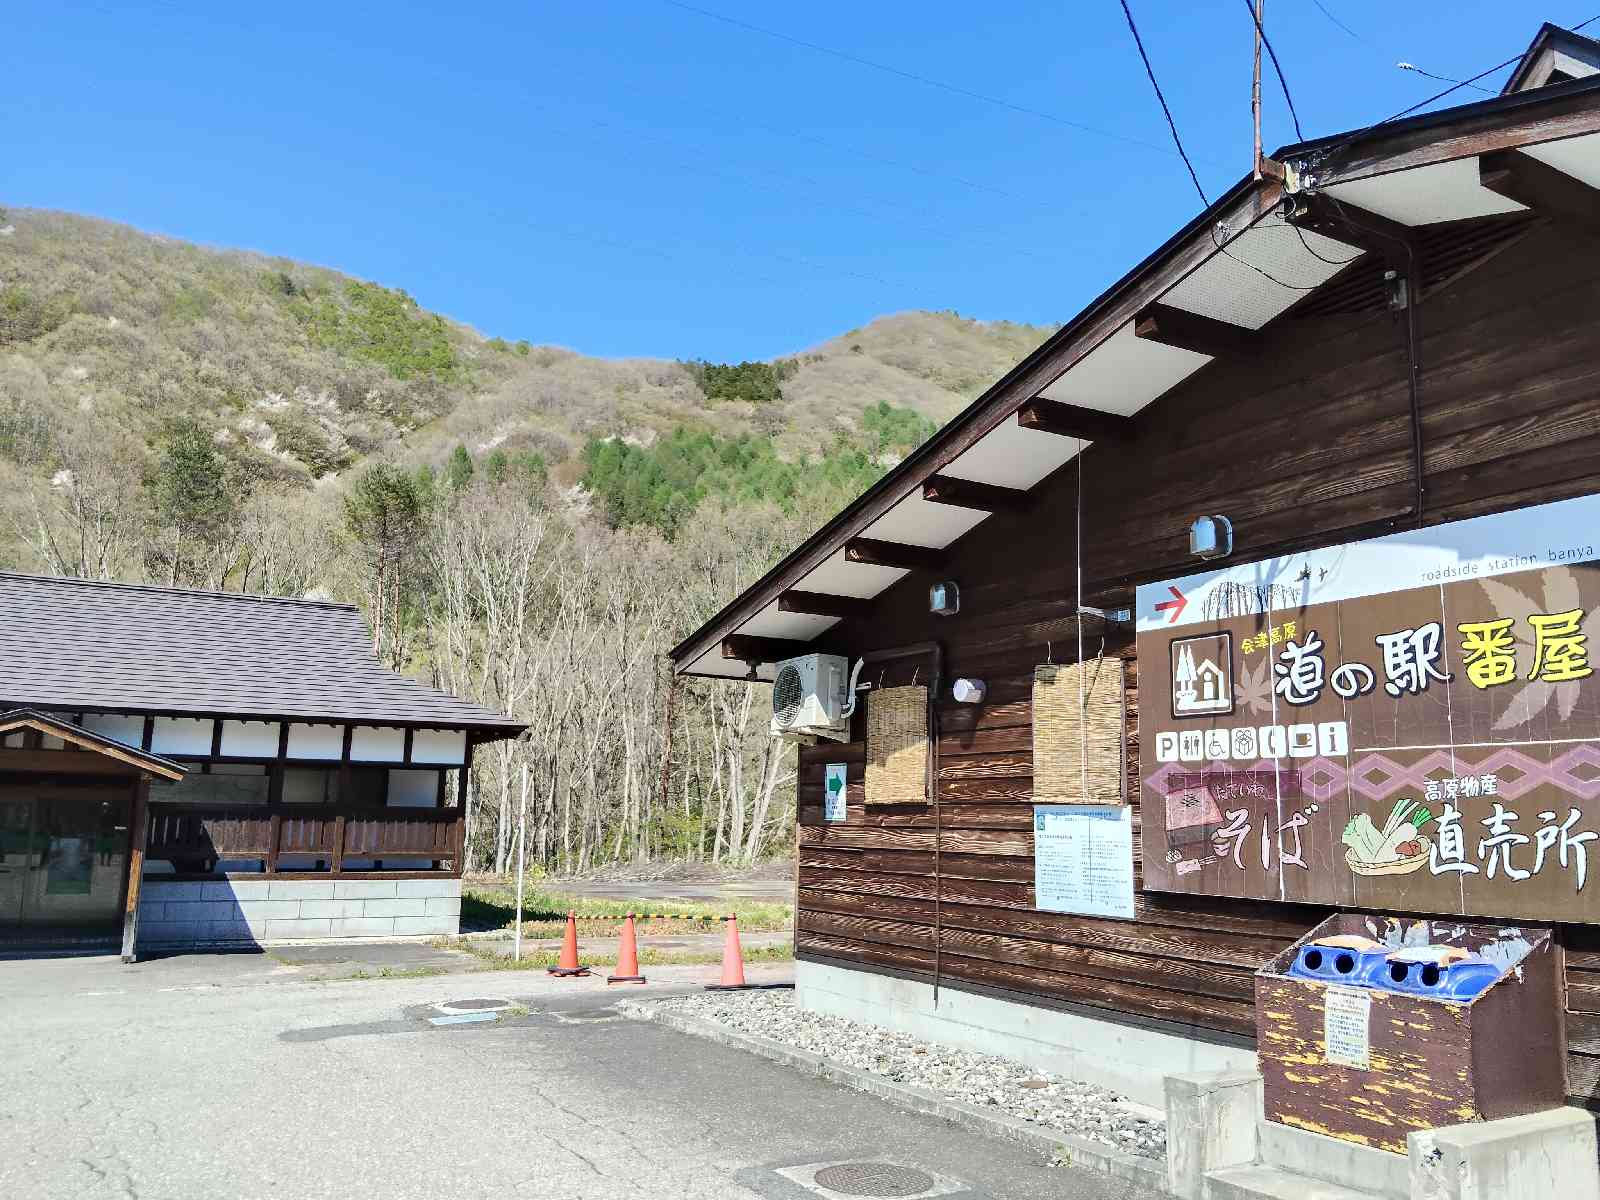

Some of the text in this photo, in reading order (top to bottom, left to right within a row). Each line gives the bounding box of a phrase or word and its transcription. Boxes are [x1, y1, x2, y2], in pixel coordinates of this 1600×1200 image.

[1421, 544, 1594, 582] roadside station banya
[1241, 621, 1297, 655] 会津高原
[1161, 737, 1174, 758] P
[1423, 773, 1499, 801] 高原物産
[1217, 803, 1319, 870] そば
[1429, 801, 1600, 895] 直売所
